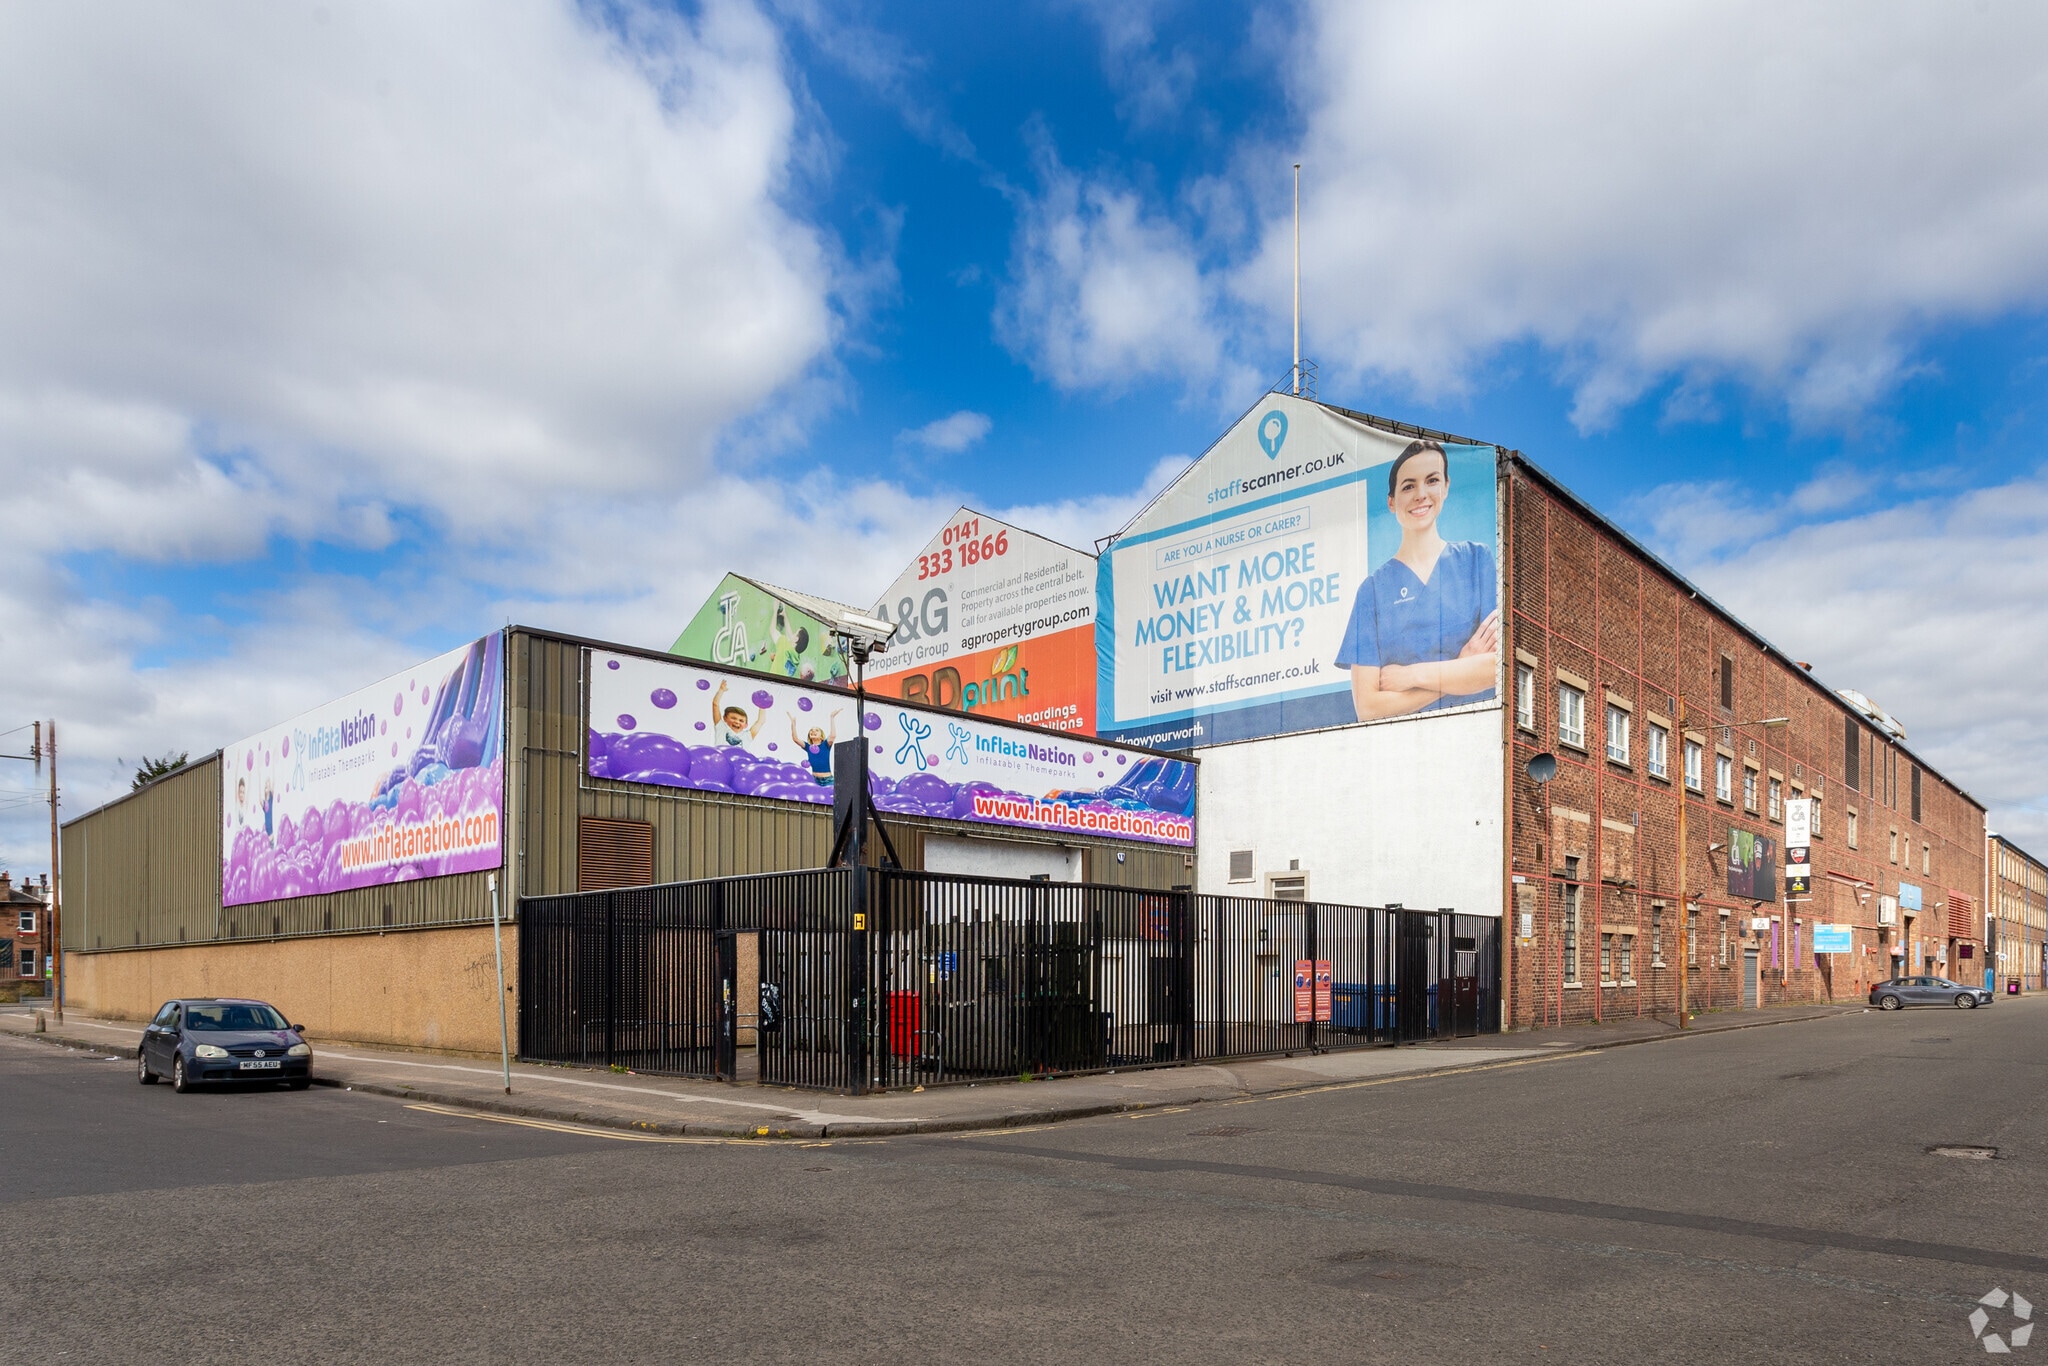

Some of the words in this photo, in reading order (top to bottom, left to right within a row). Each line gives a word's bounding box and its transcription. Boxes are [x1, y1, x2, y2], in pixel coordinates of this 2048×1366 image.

[942, 517, 979, 546] 0141
[1164, 549, 1181, 563] ARE
[1183, 544, 1203, 558] YOU
[1205, 541, 1212, 551] A
[1215, 530, 1245, 548] NURSE
[1247, 526, 1262, 539] OR
[1264, 514, 1301, 534] CARER?
[917, 548, 953, 581] 333
[958, 529, 1009, 568] 1866
[1153, 564, 1231, 610] WANT
[1237, 542, 1315, 589] MORE
[961, 579, 1006, 600] Commercial
[1006, 573, 1022, 587] and
[1023, 559, 1069, 582] Residential
[961, 597, 994, 613] Property
[995, 590, 1019, 604] across
[1020, 585, 1034, 596] the
[1035, 574, 1064, 592] central
[1065, 569, 1085, 583] belt.
[961, 617, 975, 628] Call
[976, 614, 988, 624] for
[988, 604, 1023, 620] available
[1024, 592, 1067, 614] properties
[1068, 586, 1089, 599] now.
[961, 606, 1090, 650] agpropertygroup.com
[1135, 600, 1226, 647] MONEY
[1232, 595, 1253, 625] &
[1259, 572, 1340, 619] MORE
[868, 651, 913, 672] Property
[915, 641, 949, 660] Group
[1162, 617, 1305, 674] FLEXIBILITY?
[1150, 688, 1173, 704] visit
[1175, 657, 1320, 699] www.staffscanner.co.uk
[308, 708, 376, 761] InflataNation
[1017, 704, 1077, 724] hoardings
[975, 734, 1076, 767] InflataNation
[976, 755, 1021, 770] Inflatable
[1025, 762, 1076, 779] Themeparks
[342, 812, 497, 869] www.inflatanation.com
[975, 797, 1191, 840] www.inflatanation.com
[855, 915, 864, 928] H
